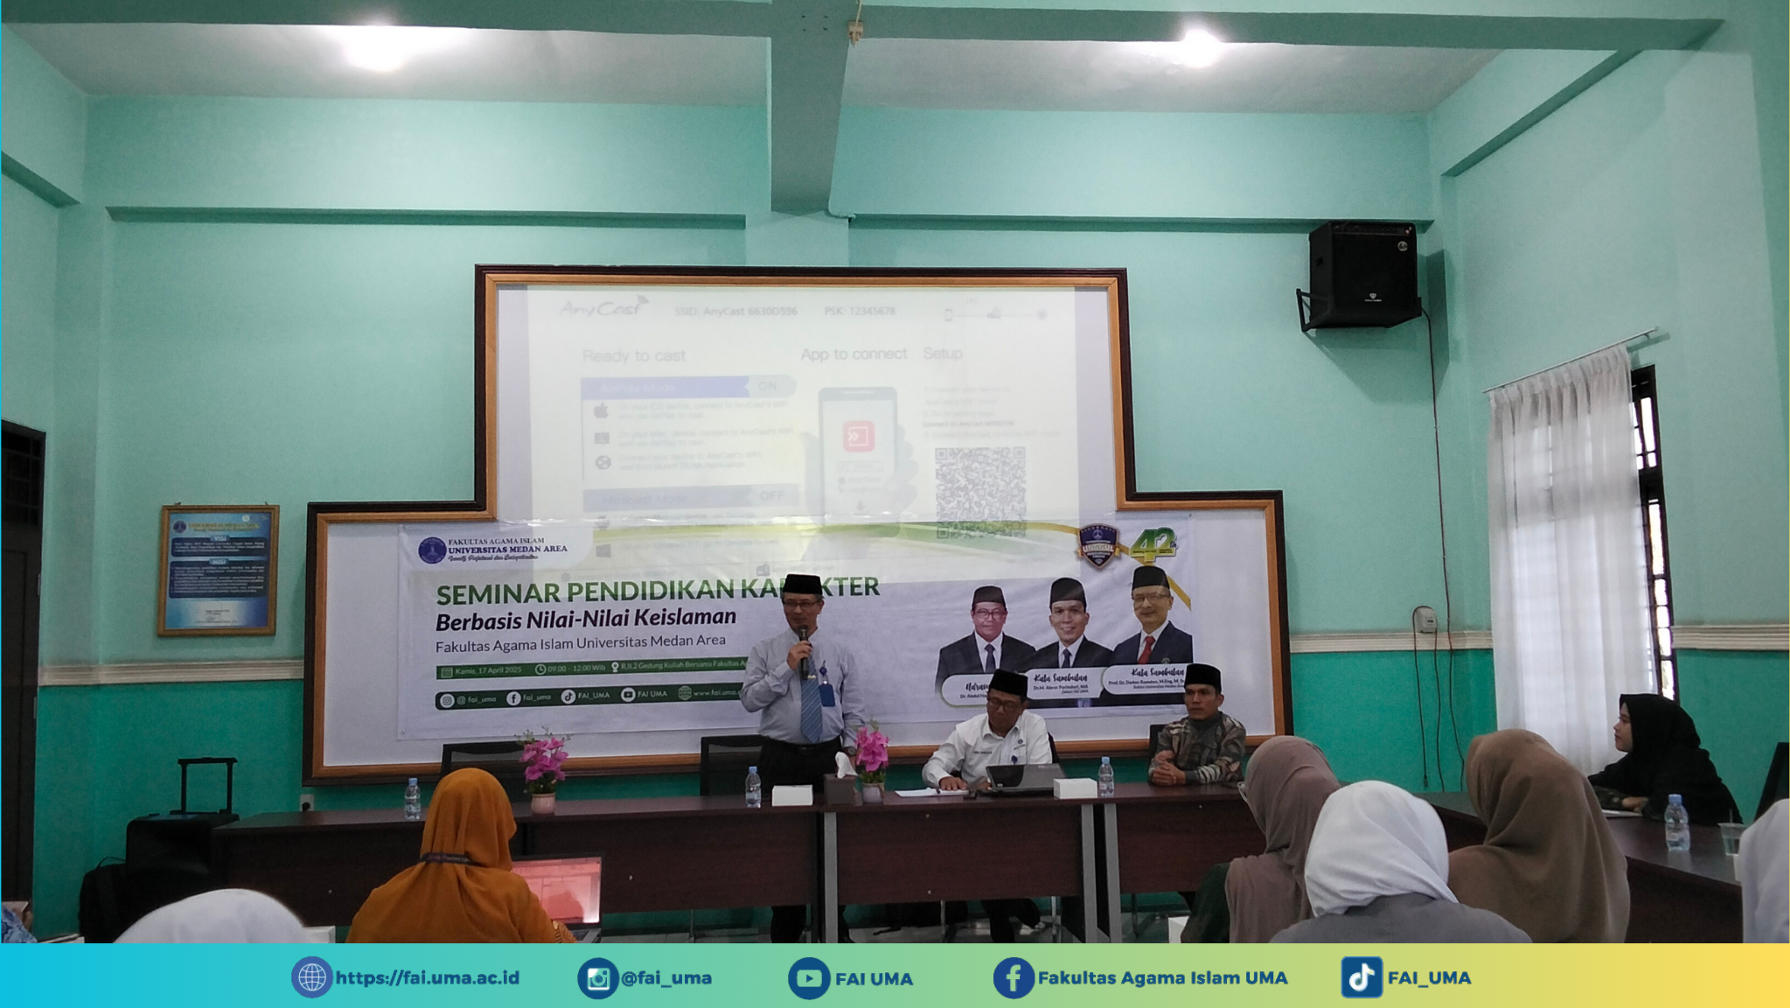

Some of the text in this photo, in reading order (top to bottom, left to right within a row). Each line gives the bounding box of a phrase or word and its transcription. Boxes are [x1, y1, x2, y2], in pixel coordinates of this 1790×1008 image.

[582, 349, 687, 366] Ready to cast
[801, 347, 908, 365] App to connect
[923, 346, 963, 363] Setup
[760, 490, 784, 501] OFF
[448, 538, 488, 546] FAKULTAS
[489, 537, 519, 545] AGAMA
[448, 546, 508, 555] UNIVERSITAS
[509, 545, 541, 553] MEDAN
[436, 583, 561, 606] SEMINAR
[567, 579, 734, 602] PENDIDIKAN
[435, 607, 737, 632] Berbasis Nilai-Nilai Keislaman
[436, 634, 726, 653] Fakultas Agama Islam Universitas Medan Area
[487, 666, 504, 675] April
[522, 693, 552, 701] fai_uma
[577, 691, 611, 700] FAI_UMA
[650, 690, 668, 698] UMA
[467, 695, 497, 704] fai_uma
